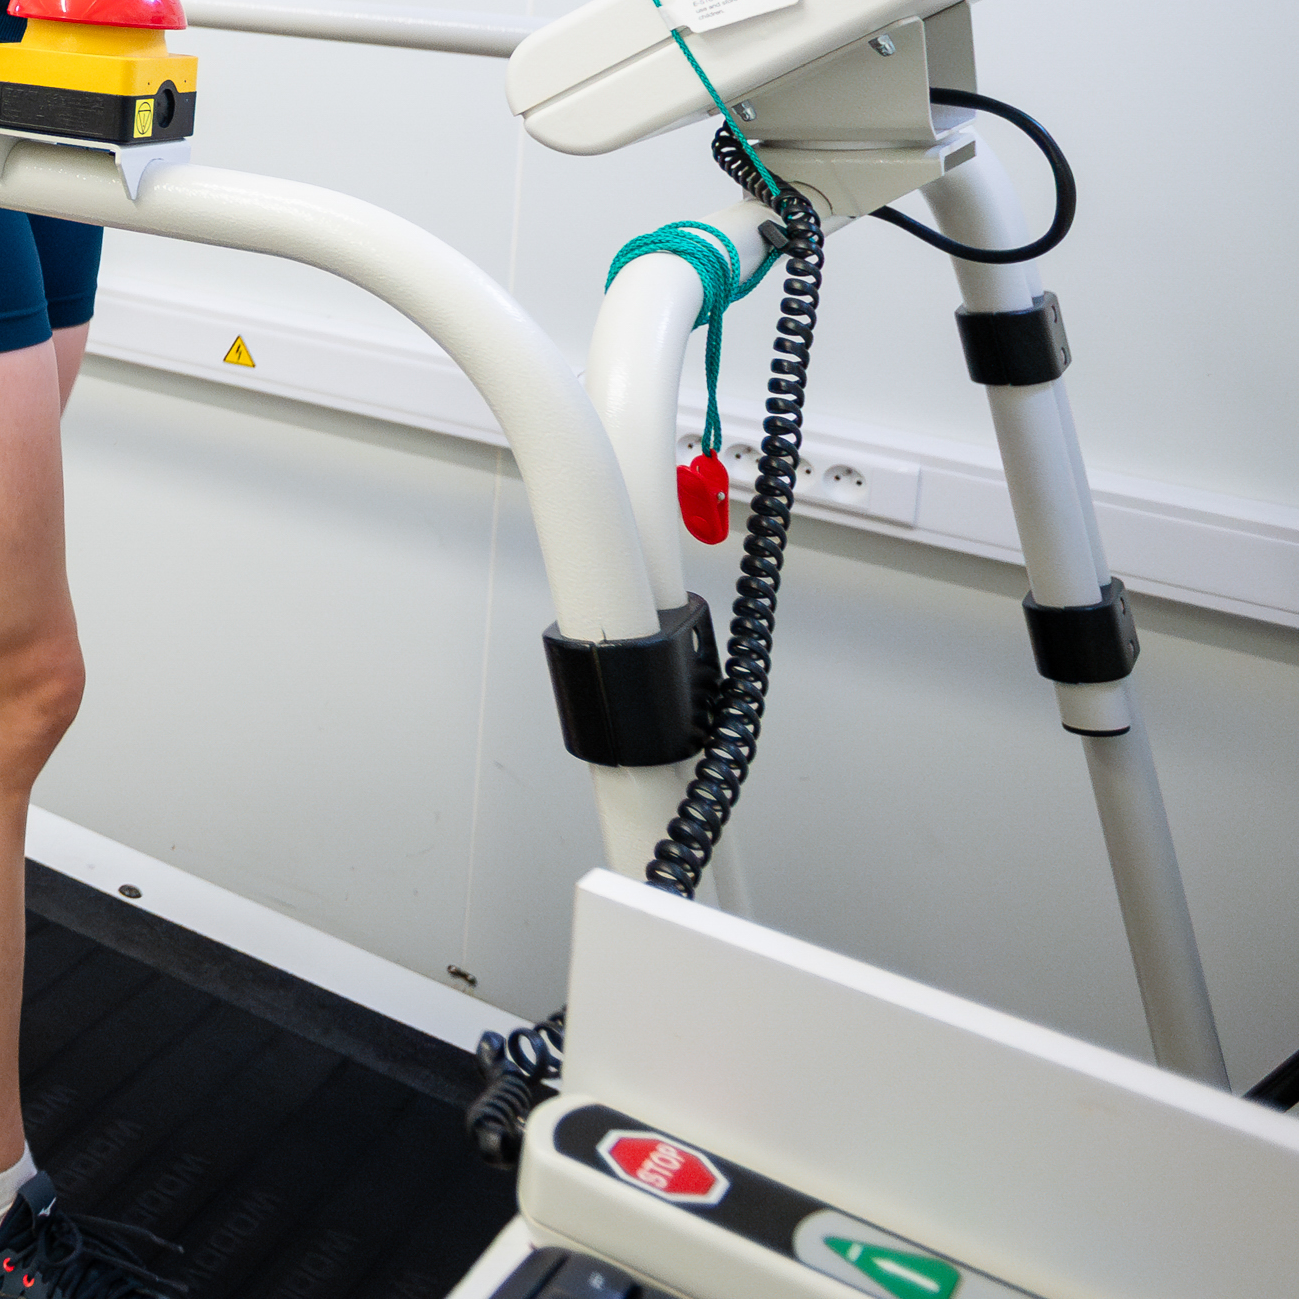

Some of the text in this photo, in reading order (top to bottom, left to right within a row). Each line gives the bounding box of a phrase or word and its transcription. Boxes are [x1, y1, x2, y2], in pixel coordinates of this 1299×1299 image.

[696, 6, 707, 15] use
[708, 2, 721, 11] and
[636, 1142, 688, 1190] STOP
